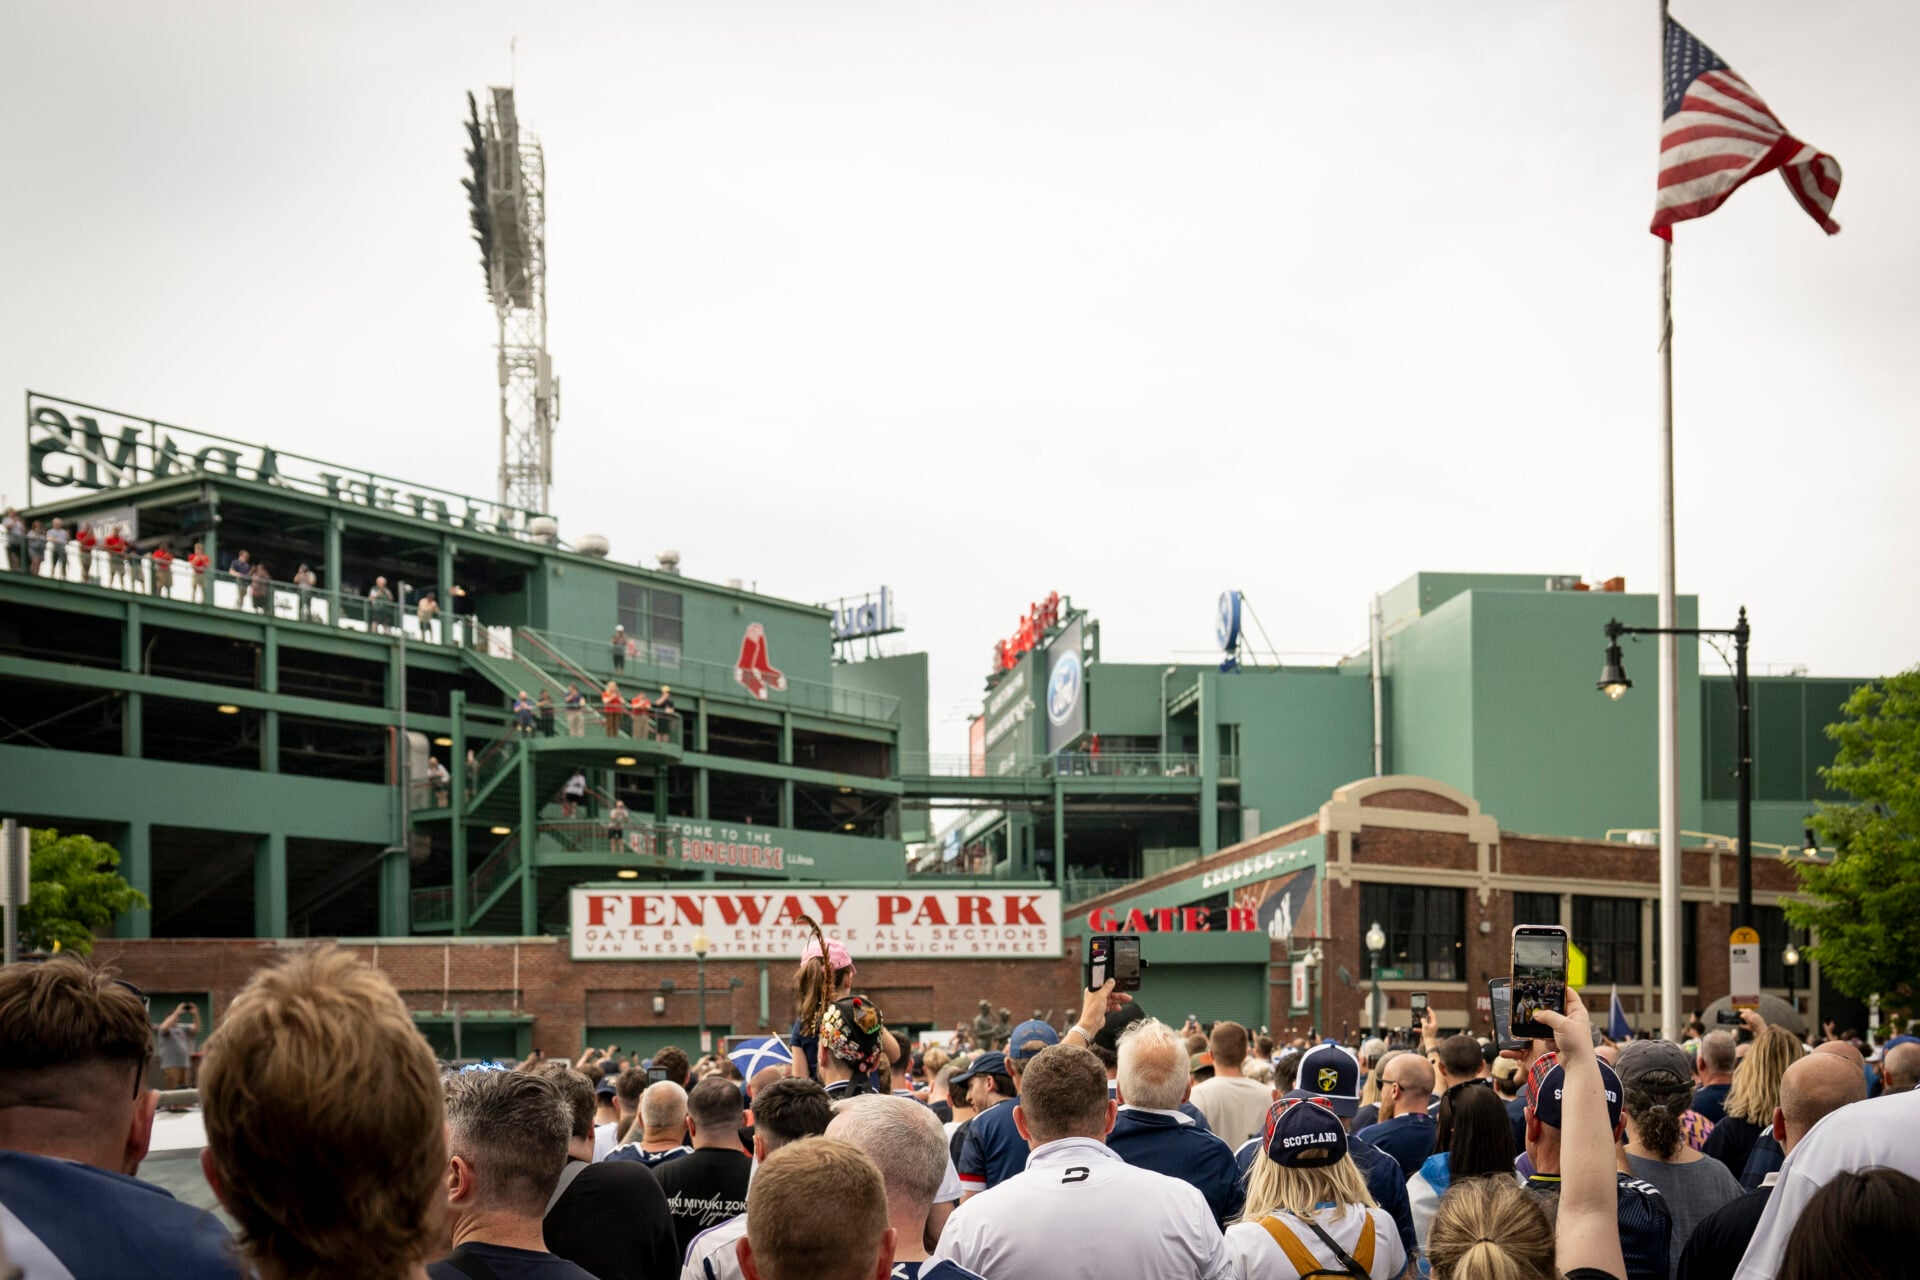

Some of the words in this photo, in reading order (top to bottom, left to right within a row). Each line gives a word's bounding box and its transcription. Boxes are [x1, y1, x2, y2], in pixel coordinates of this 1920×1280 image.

[831, 585, 892, 637] ual
[720, 828, 739, 841] TO
[746, 831, 772, 844] THE
[681, 837, 784, 870] CONCOURSE
[587, 895, 848, 926] FENWAY
[876, 895, 1046, 926] PARK
[1087, 906, 1211, 933] GATE
[1226, 906, 1258, 933] B
[585, 929, 645, 941] GATE
[663, 929, 674, 941] B
[734, 929, 858, 941] ENTRACE
[875, 929, 916, 940] ALL
[933, 929, 1048, 940] SECTIONS
[585, 943, 623, 953] VAN
[640, 943, 692, 953] NESS
[710, 943, 788, 953] STREET
[866, 942, 955, 952] IPSWICH
[971, 942, 1048, 952] STREET
[1283, 1132, 1337, 1148] SCOTLAND
[684, 1199, 722, 1210] MIYUKI
